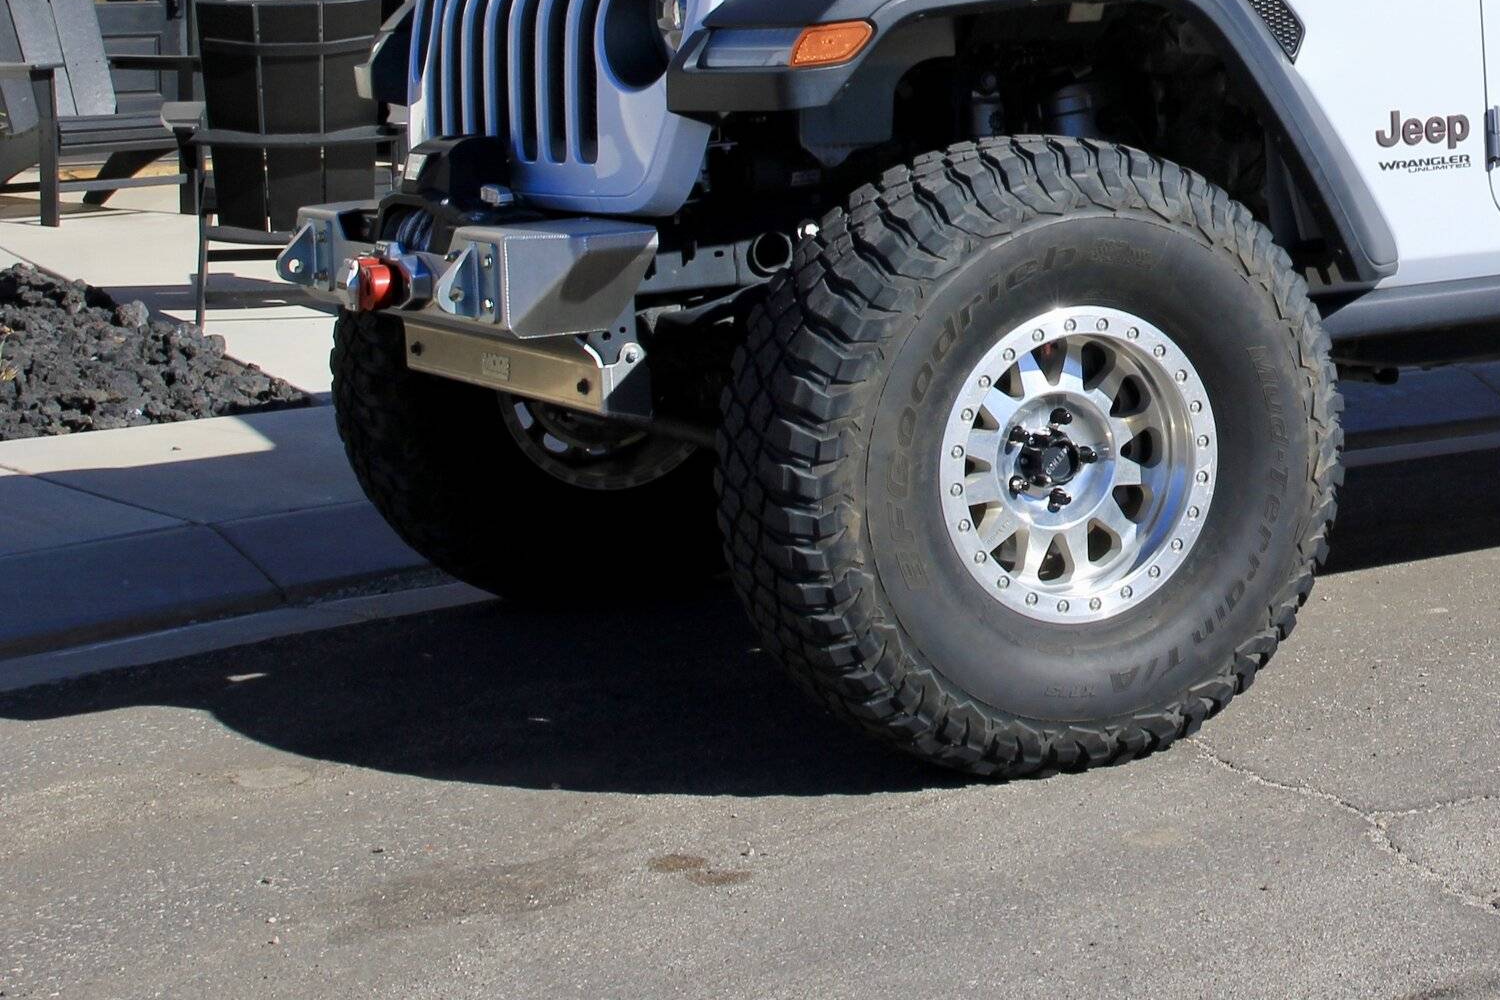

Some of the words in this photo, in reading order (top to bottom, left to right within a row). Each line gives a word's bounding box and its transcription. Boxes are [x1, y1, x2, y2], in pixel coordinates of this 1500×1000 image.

[1375, 110, 1470, 149] Jeep
[1378, 154, 1470, 171] WRANGLER
[1408, 163, 1471, 173] UNLIMITED
[886, 246, 1077, 591] BFGoodrich
